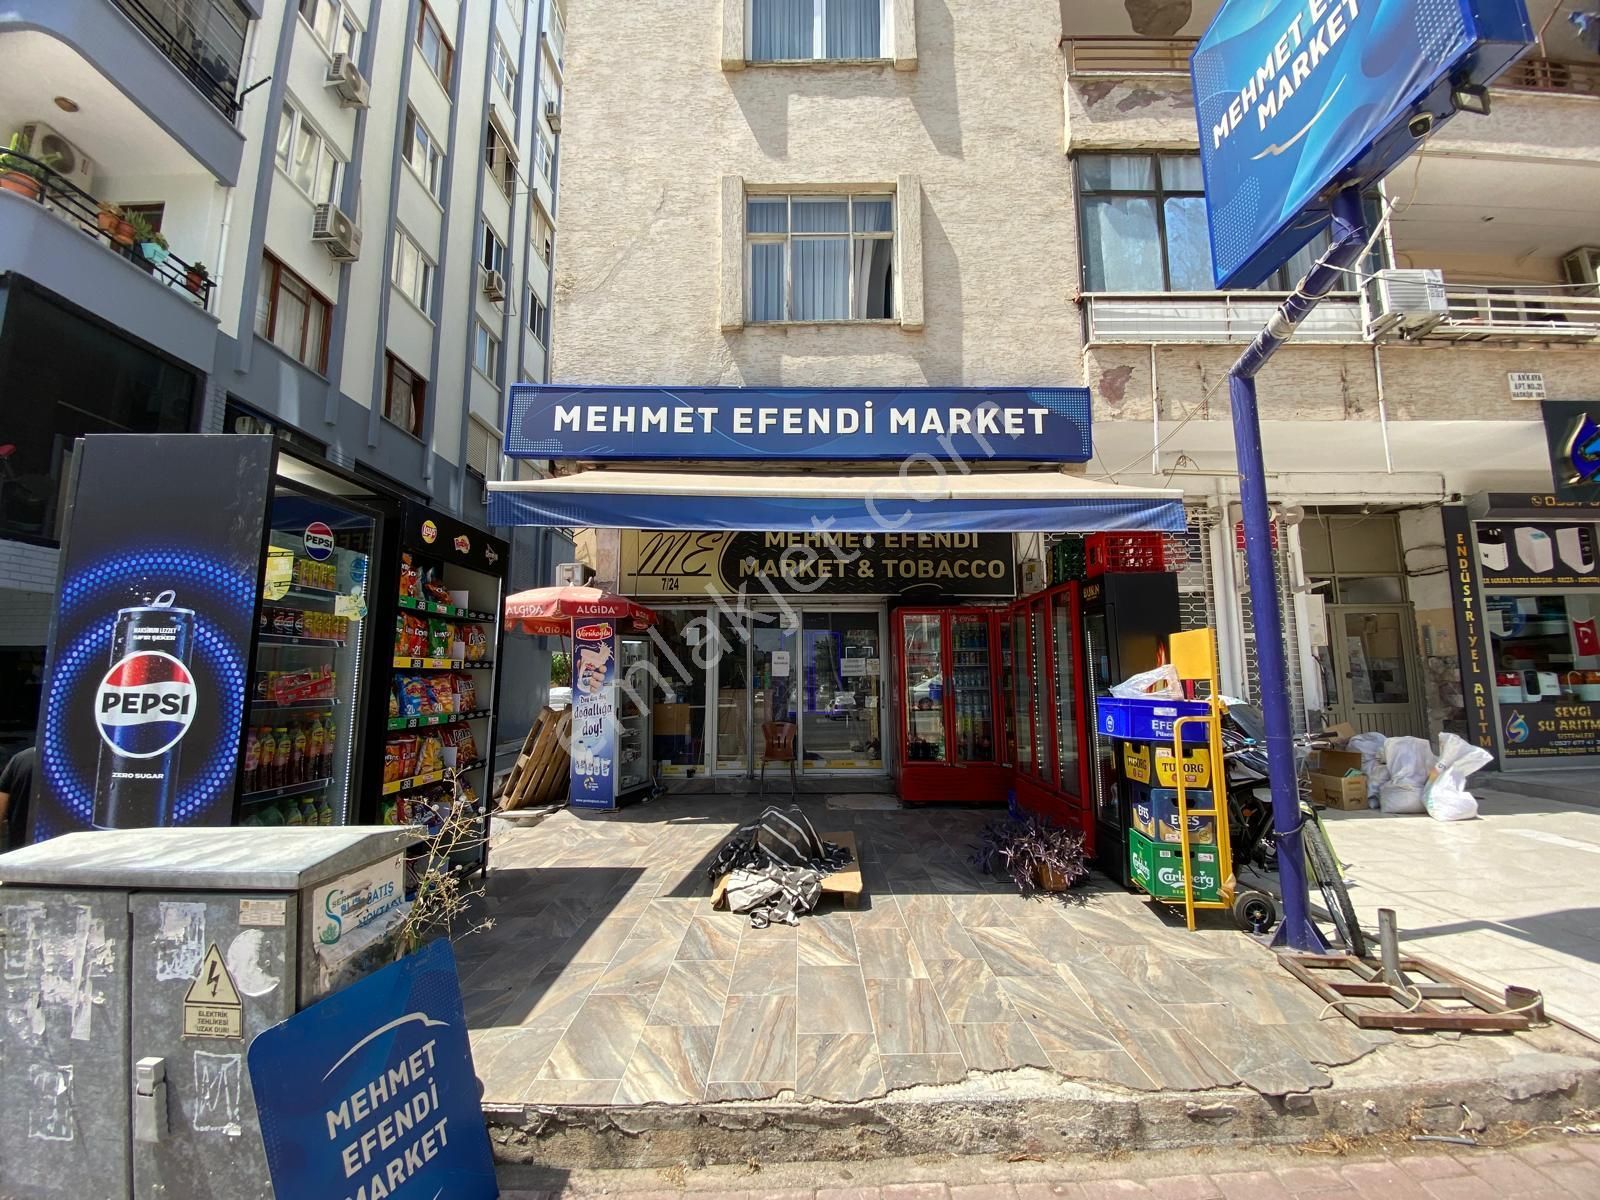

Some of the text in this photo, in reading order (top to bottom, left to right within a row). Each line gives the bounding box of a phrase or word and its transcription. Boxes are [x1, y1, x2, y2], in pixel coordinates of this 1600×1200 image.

[1257, 0, 1359, 131] MARKET
[1212, 11, 1303, 149] MEHMET
[553, 401, 1049, 434] MEHMET EFENDİ MARKET
[306, 534, 333, 549] PEPSI
[765, 531, 873, 548] MEHMET
[740, 559, 1006, 579] MARKET & TOBACCO
[662, 578, 679, 591] 7/24
[577, 626, 611, 639] Yörükoğlu
[101, 692, 191, 715] PEPSI
[574, 703, 613, 719] doğallığa
[1554, 706, 1591, 717] SEVGİ
[582, 717, 604, 738] doy!
[1151, 719, 1175, 730] EFE
[1537, 720, 1555, 731] SU
[1162, 763, 1204, 773] TUORG
[1171, 814, 1200, 826] EES
[1158, 867, 1214, 888] Carlserg
[197, 1018, 229, 1026] TEHLİKESİ
[198, 1010, 228, 1018] ELEKTRİK
[326, 1039, 436, 1140] MEHMET
[341, 1077, 439, 1178] EFENDİ
